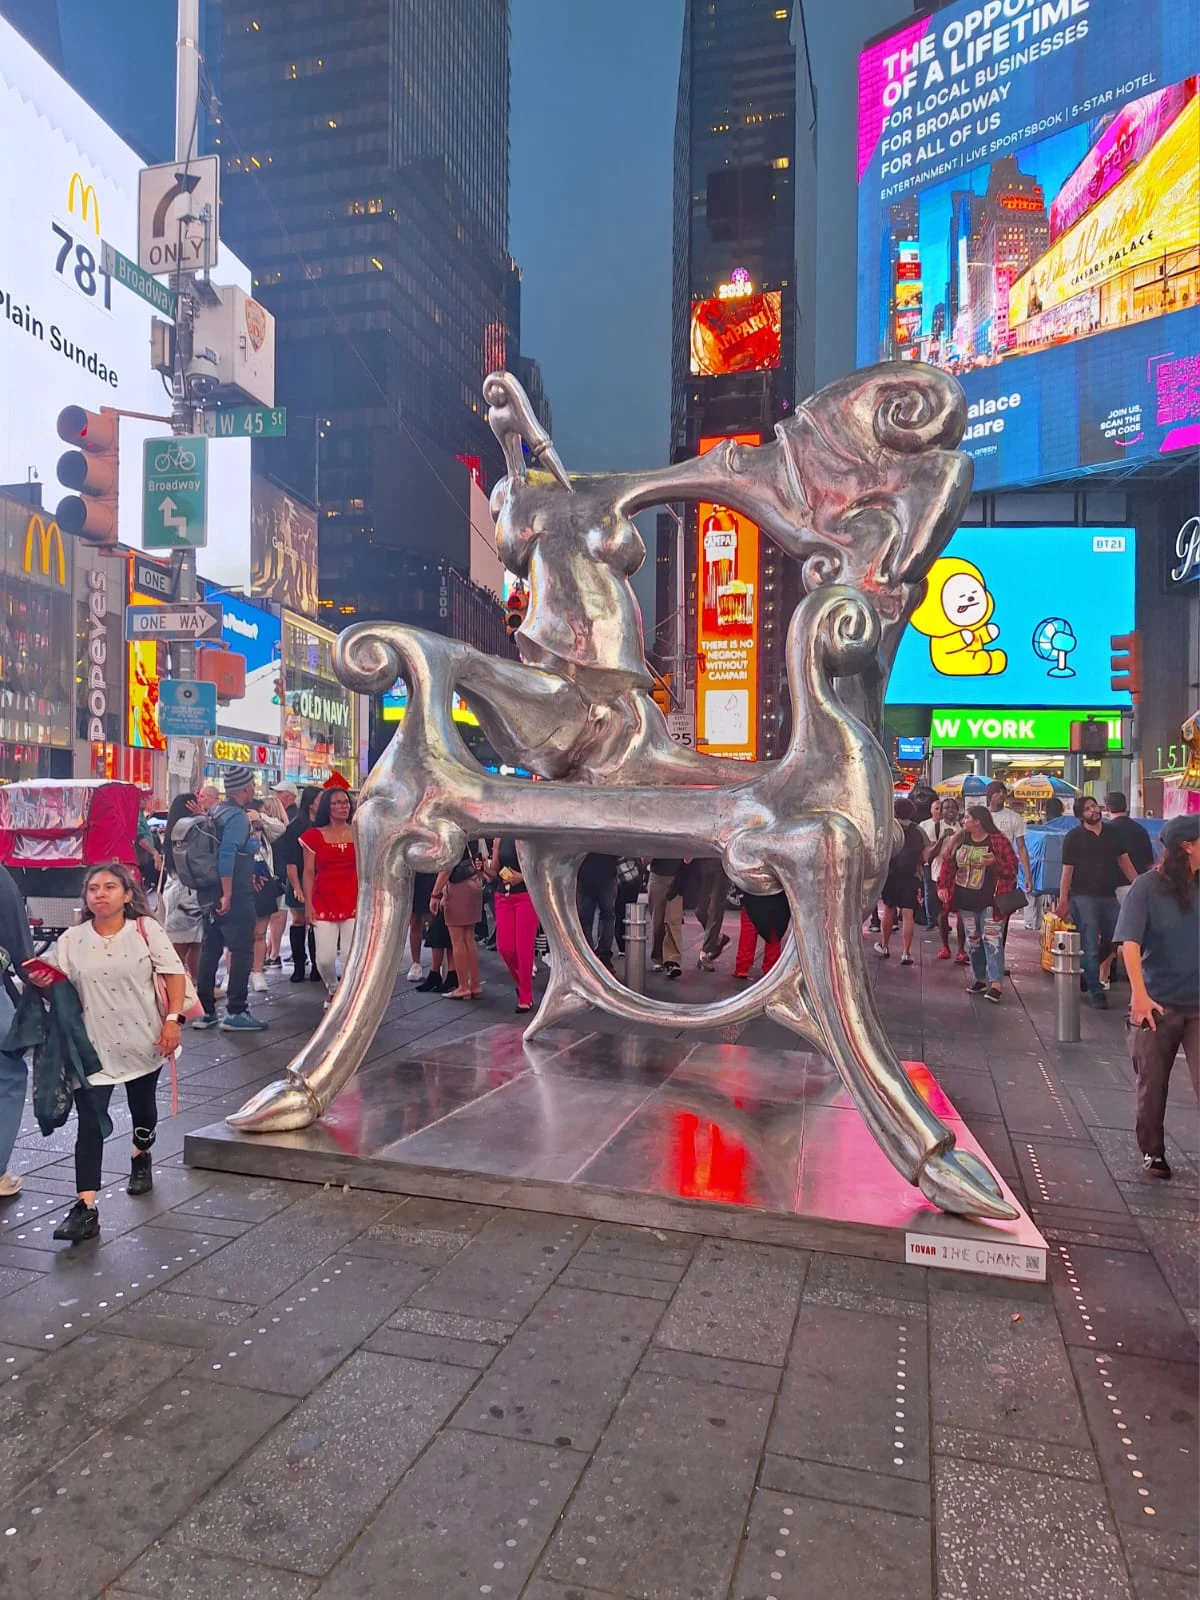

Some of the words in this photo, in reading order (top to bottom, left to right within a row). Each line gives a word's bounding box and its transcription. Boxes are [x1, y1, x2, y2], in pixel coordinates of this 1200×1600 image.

[883, 33, 936, 80] THE
[942, 0, 1042, 48] OPPO
[883, 71, 917, 108] OF
[924, 60, 944, 90] A
[951, 0, 1090, 76] LIFETIME
[882, 106, 912, 133] FOR
[917, 79, 970, 116] LOCAL
[975, 20, 1089, 89] BUSINESSES
[882, 128, 912, 157] FOR
[916, 82, 1011, 141] BROADWAY
[881, 158, 958, 200] ENTERTAINMENT
[966, 145, 987, 163] LIVE
[990, 112, 1063, 153] SPORTSBOOK
[1071, 90, 1113, 117] 5-STAR
[1115, 72, 1157, 98] HOTEL
[882, 151, 912, 179] FOR
[916, 138, 945, 164] ALL
[950, 125, 972, 147] OF
[977, 112, 1001, 136] US
[150, 238, 205, 265] ONLY
[119, 254, 175, 316] Broadway
[715, 310, 768, 351] AMPARI
[50, 325, 119, 388] Sundae
[967, 392, 1022, 419] alace
[1108, 407, 1127, 419] JOIN
[220, 414, 235, 434] W
[243, 413, 264, 434] 45
[271, 411, 283, 426] St
[962, 418, 1005, 441] uare
[1100, 419, 1123, 431] SCAN
[1124, 413, 1142, 425] THE
[1105, 430, 1117, 439] QR
[1118, 423, 1142, 436] CODE
[148, 480, 201, 492] Broadway
[1096, 540, 1121, 549] BT21
[144, 570, 165, 591] ONE
[140, 616, 167, 629] ONE
[179, 614, 208, 629] WAY
[702, 640, 728, 650] THERE
[730, 640, 738, 648] IS
[740, 639, 754, 648] NO
[708, 651, 747, 660] NEGRONI
[706, 660, 748, 670] WITHOUT
[708, 671, 747, 680] CAMPARI
[300, 692, 322, 721] OLD
[323, 698, 349, 727] NAVY
[967, 719, 1035, 739] YORK
[214, 739, 250, 763] GIFTS
[911, 1243, 936, 1256] TOVAR
[940, 1245, 971, 1261] THE
